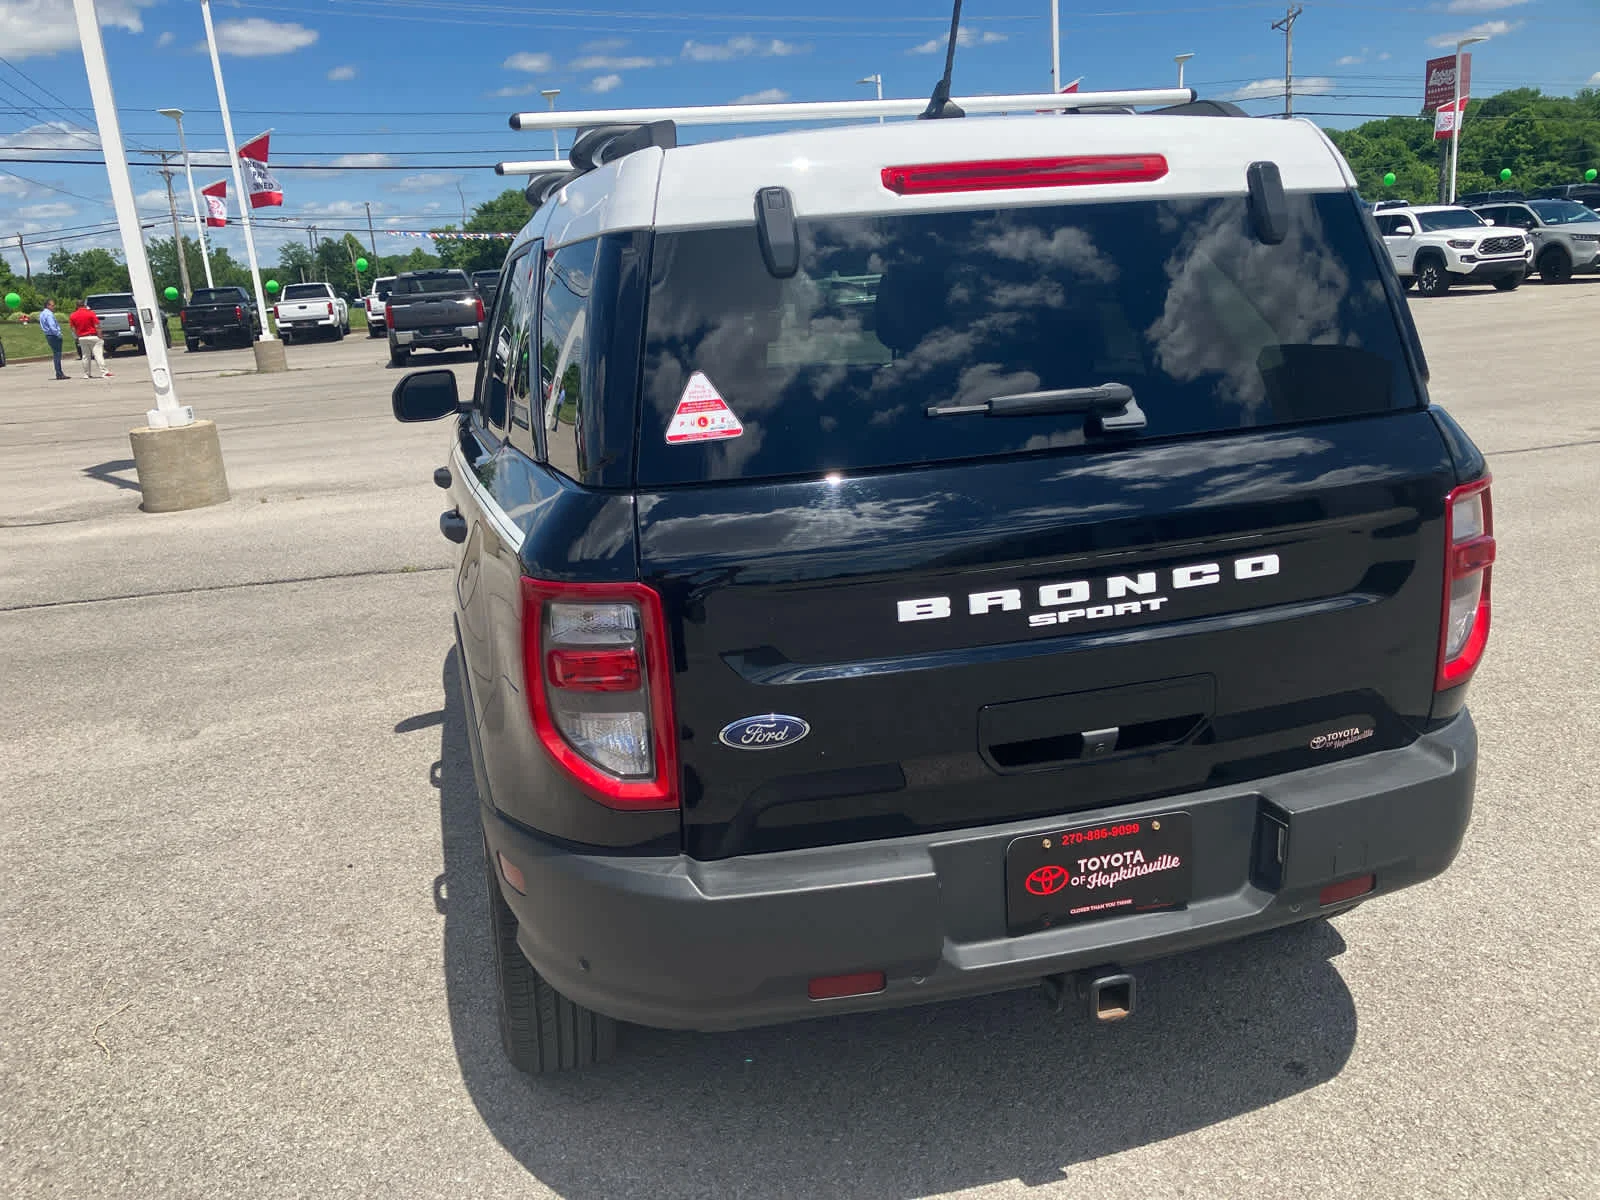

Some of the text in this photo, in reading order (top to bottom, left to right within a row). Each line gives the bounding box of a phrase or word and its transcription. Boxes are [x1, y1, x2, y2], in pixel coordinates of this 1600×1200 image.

[897, 553, 1280, 623] BRONCO
[1028, 597, 1169, 627] SPORT
[741, 723, 789, 744] Ford
[1327, 728, 1359, 741] TOYOTA
[1061, 823, 1140, 846] 270-886-9099
[1071, 855, 1180, 889] OF Hopkinsville
[1077, 850, 1145, 873] TOYOTA
[1070, 907, 1090, 915] CLOSER
